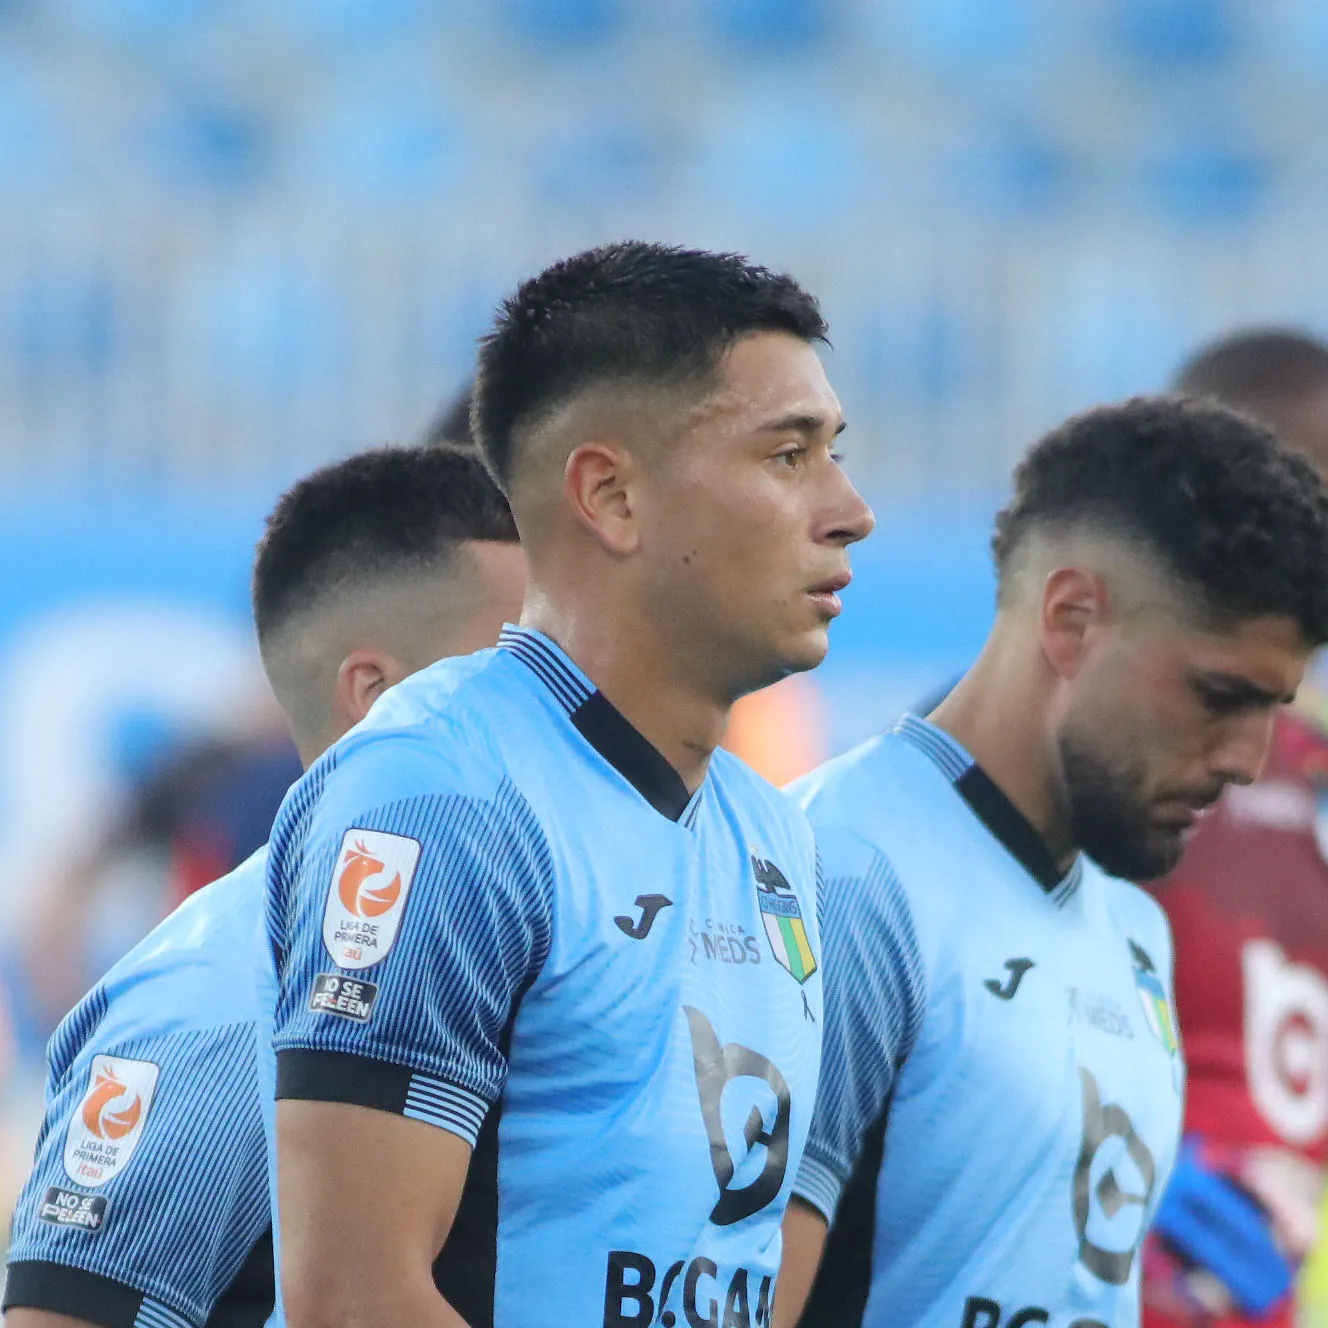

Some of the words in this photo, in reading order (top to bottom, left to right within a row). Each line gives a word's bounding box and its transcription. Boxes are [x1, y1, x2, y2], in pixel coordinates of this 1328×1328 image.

[81, 1139, 104, 1152] LIGA
[105, 1145, 120, 1157] DE
[72, 1149, 116, 1167] PRIMERA
[56, 1192, 79, 1209] NO
